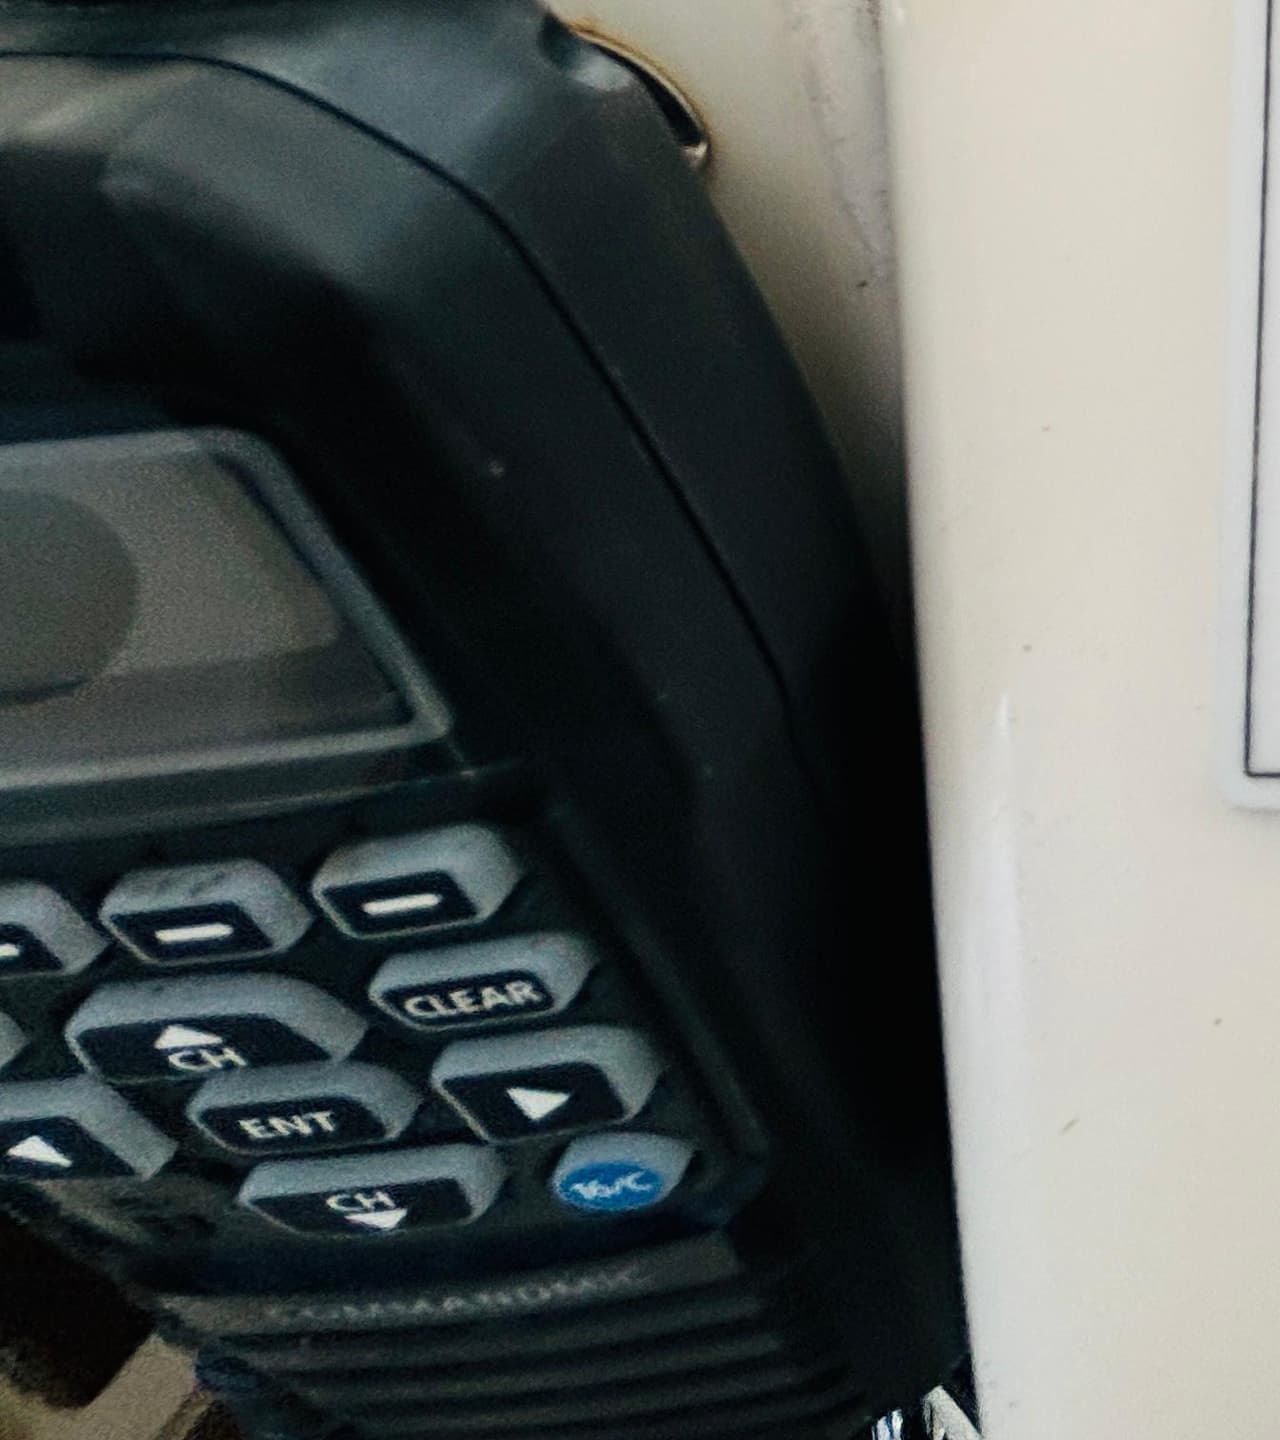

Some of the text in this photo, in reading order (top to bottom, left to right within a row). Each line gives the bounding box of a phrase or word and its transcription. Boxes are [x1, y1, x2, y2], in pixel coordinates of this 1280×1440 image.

[404, 978, 544, 1019] CLEAR
[167, 1045, 248, 1072] CH
[238, 1110, 338, 1140] ENT
[325, 1190, 398, 1214] CH
